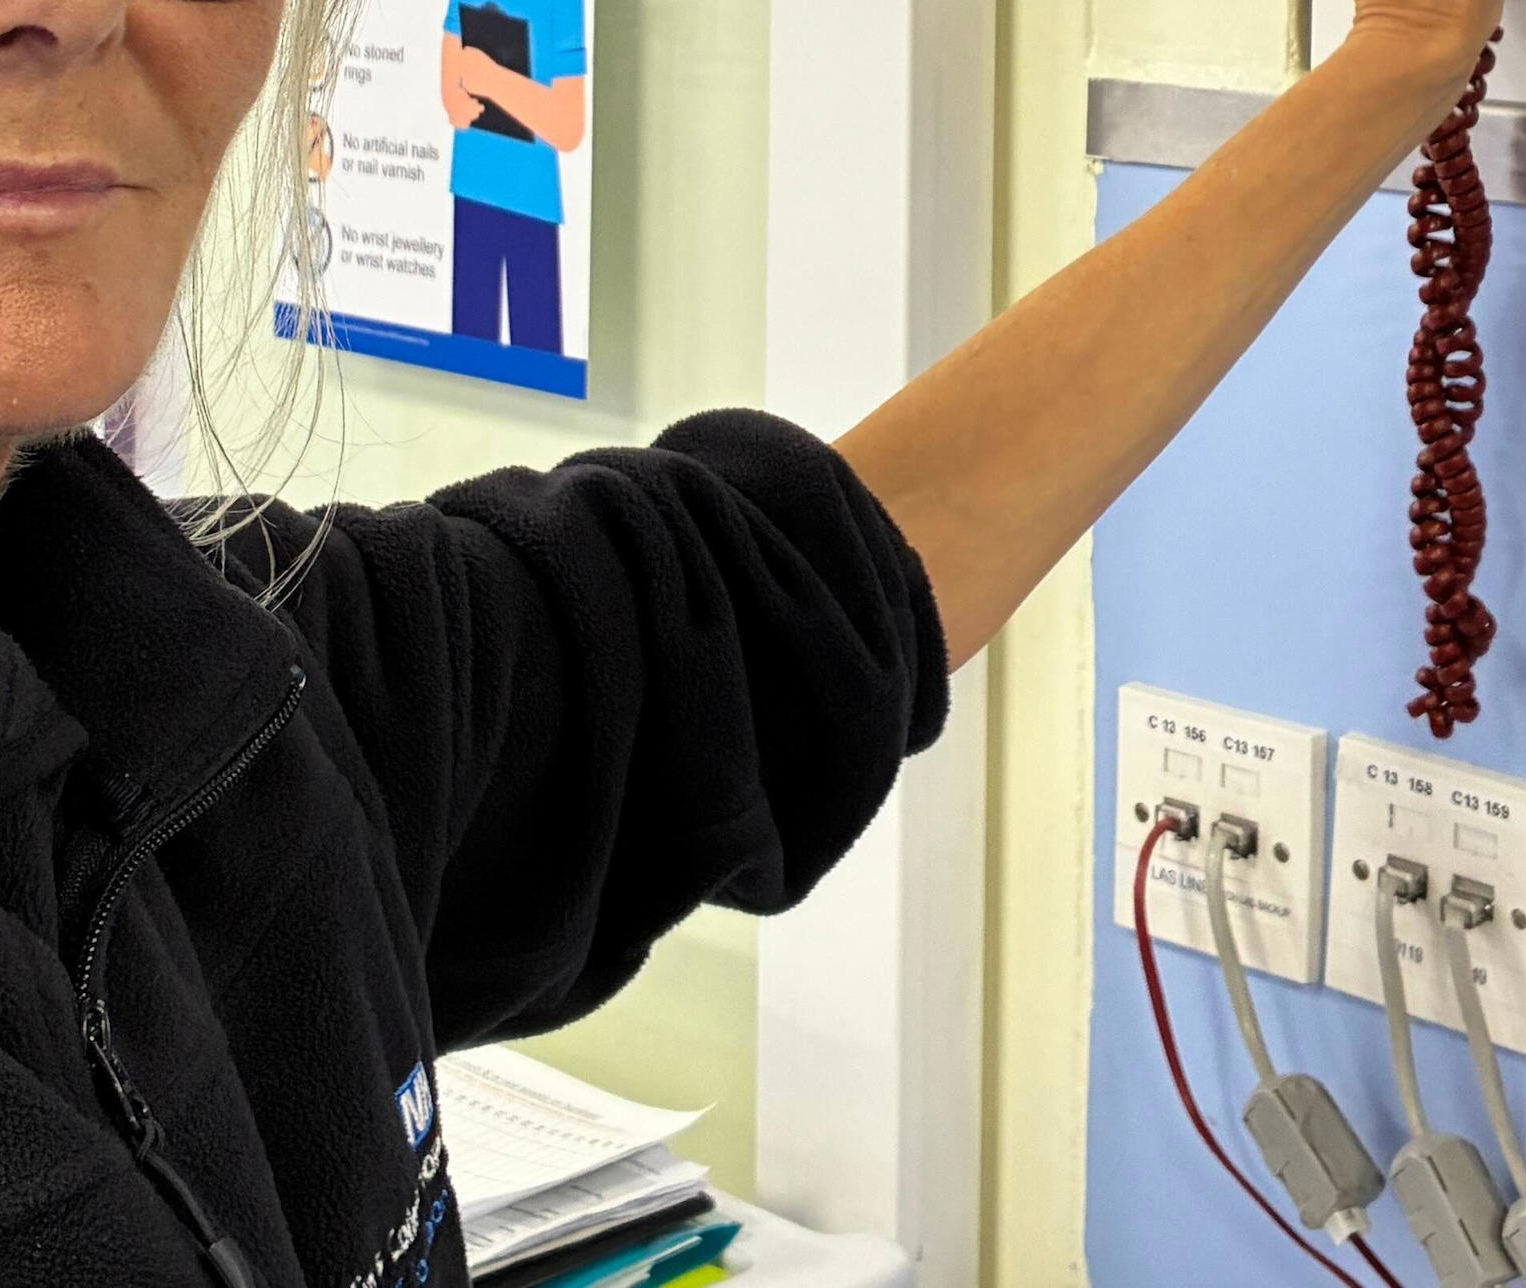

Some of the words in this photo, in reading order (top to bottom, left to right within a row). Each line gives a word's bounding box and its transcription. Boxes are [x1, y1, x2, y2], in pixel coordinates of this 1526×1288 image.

[363, 44, 405, 63] stoned
[344, 65, 372, 85] rings
[343, 133, 360, 150] No
[362, 136, 409, 156] artificial
[411, 142, 440, 161] nails
[342, 158, 354, 172] or
[357, 158, 379, 175] nail
[381, 163, 426, 182] varnish
[341, 223, 359, 242] No
[361, 231, 389, 248] wrist
[391, 234, 445, 261] jewellery
[341, 250, 353, 263] or
[356, 253, 384, 270] wrist
[386, 258, 436, 278] watches
[1148, 715, 1159, 729] C
[1162, 719, 1177, 734] 13
[1184, 726, 1207, 743] 156
[1223, 735, 1249, 755] C13
[1253, 744, 1276, 762] 157
[1367, 764, 1379, 779] C
[1383, 769, 1399, 786] 13
[1408, 777, 1434, 796] 158
[1451, 790, 1480, 811] C13
[1484, 799, 1510, 820] 159
[1151, 864, 1177, 885] LAS
